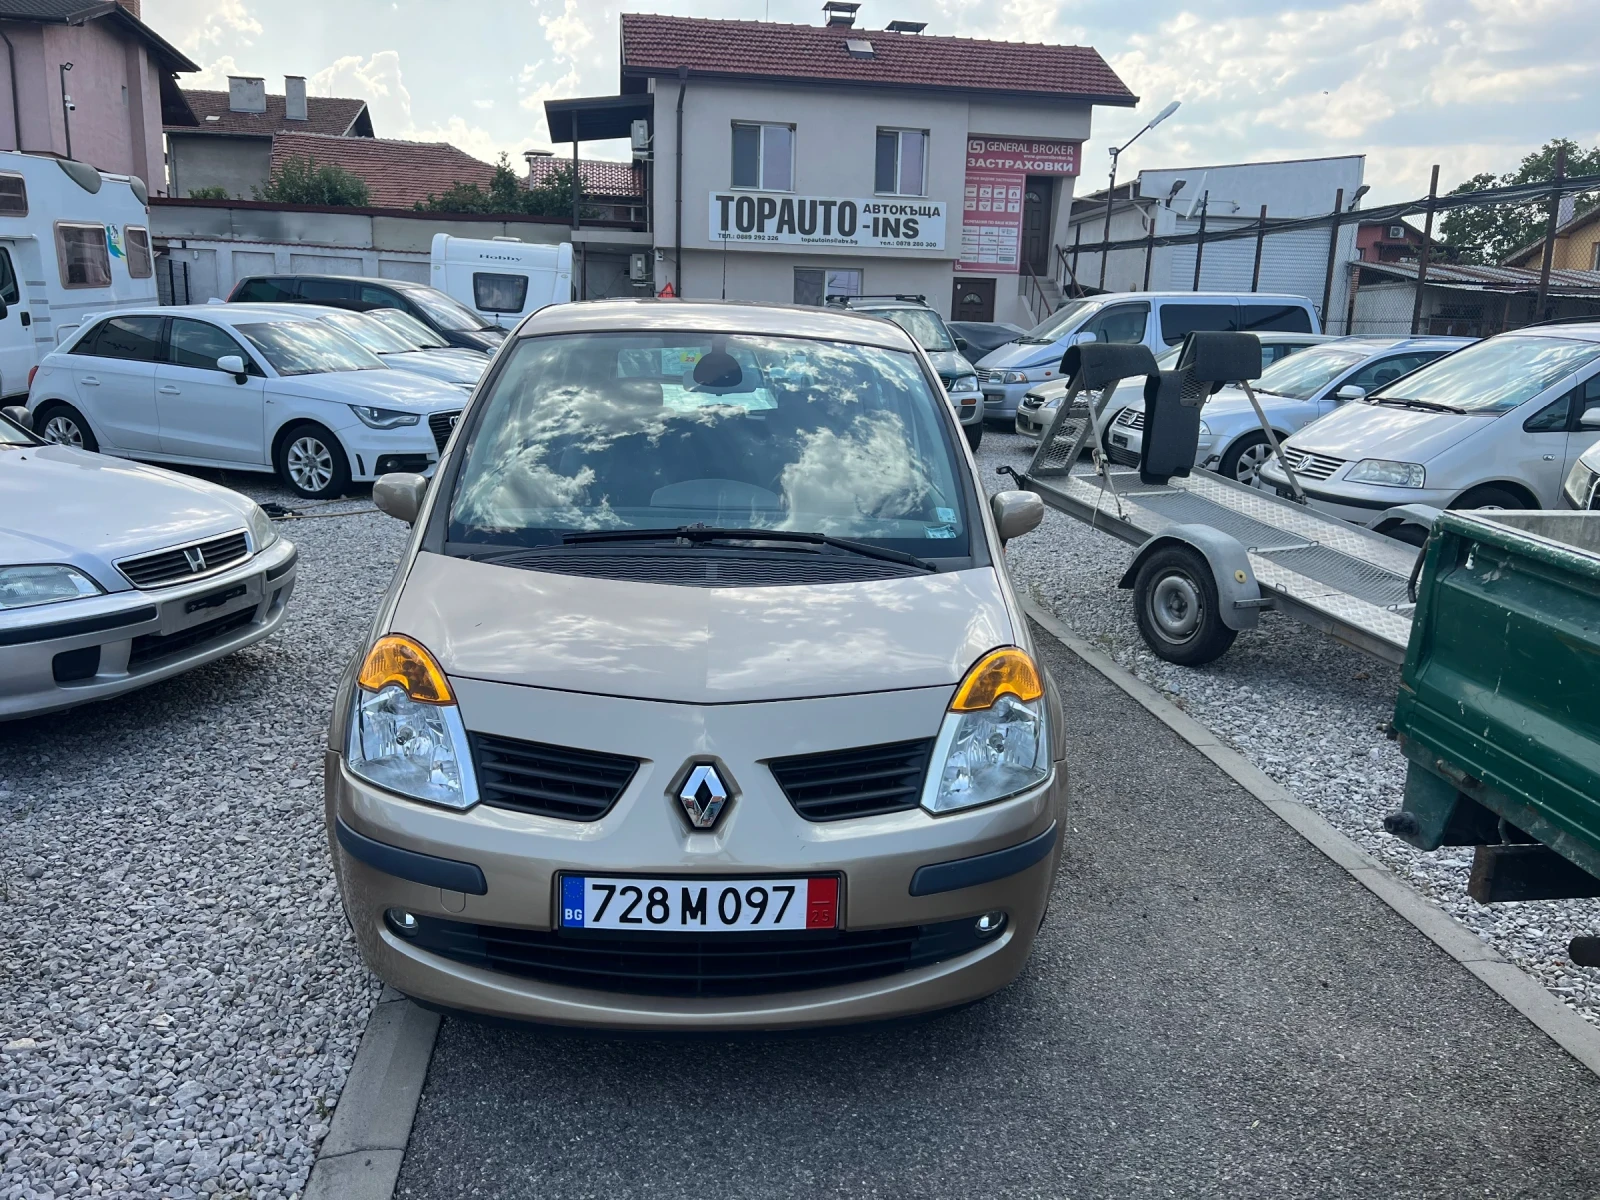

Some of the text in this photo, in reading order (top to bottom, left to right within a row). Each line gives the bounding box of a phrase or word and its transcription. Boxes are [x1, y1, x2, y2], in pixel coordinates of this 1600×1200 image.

[987, 141, 1074, 155] GENERAL BROKER
[967, 158, 1073, 172] ЗАСТРАХОВКИ
[716, 195, 857, 237] TOPAUTO
[863, 203, 941, 218] АВТОКЪЩА
[480, 254, 522, 262] Hobby
[564, 908, 583, 921] BG
[592, 884, 670, 925] 728
[681, 887, 708, 926] M
[718, 886, 796, 925] 097
